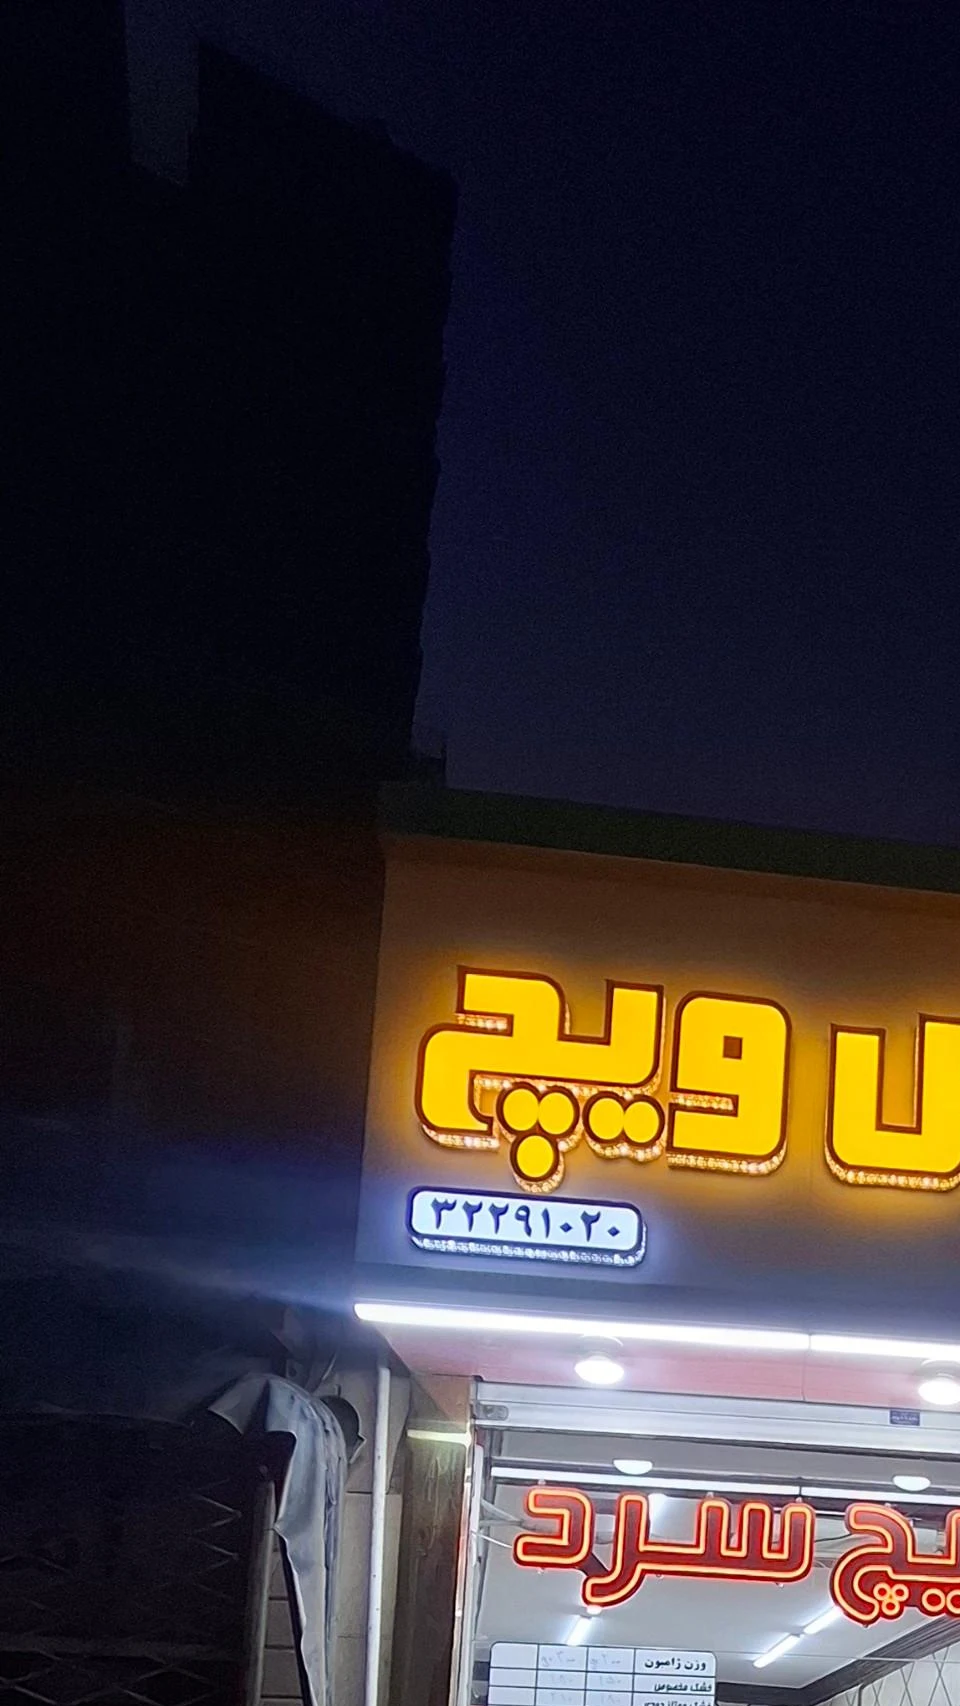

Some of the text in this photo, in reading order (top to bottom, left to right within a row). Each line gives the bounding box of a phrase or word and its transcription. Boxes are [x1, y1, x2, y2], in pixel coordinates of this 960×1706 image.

[415, 966, 792, 1192] ویچ
[430, 1197, 620, 1242] ۳۲۲۹۱۰۲۰
[513, 1486, 815, 1608] سرد
[684, 1660, 706, 1671] وزن
